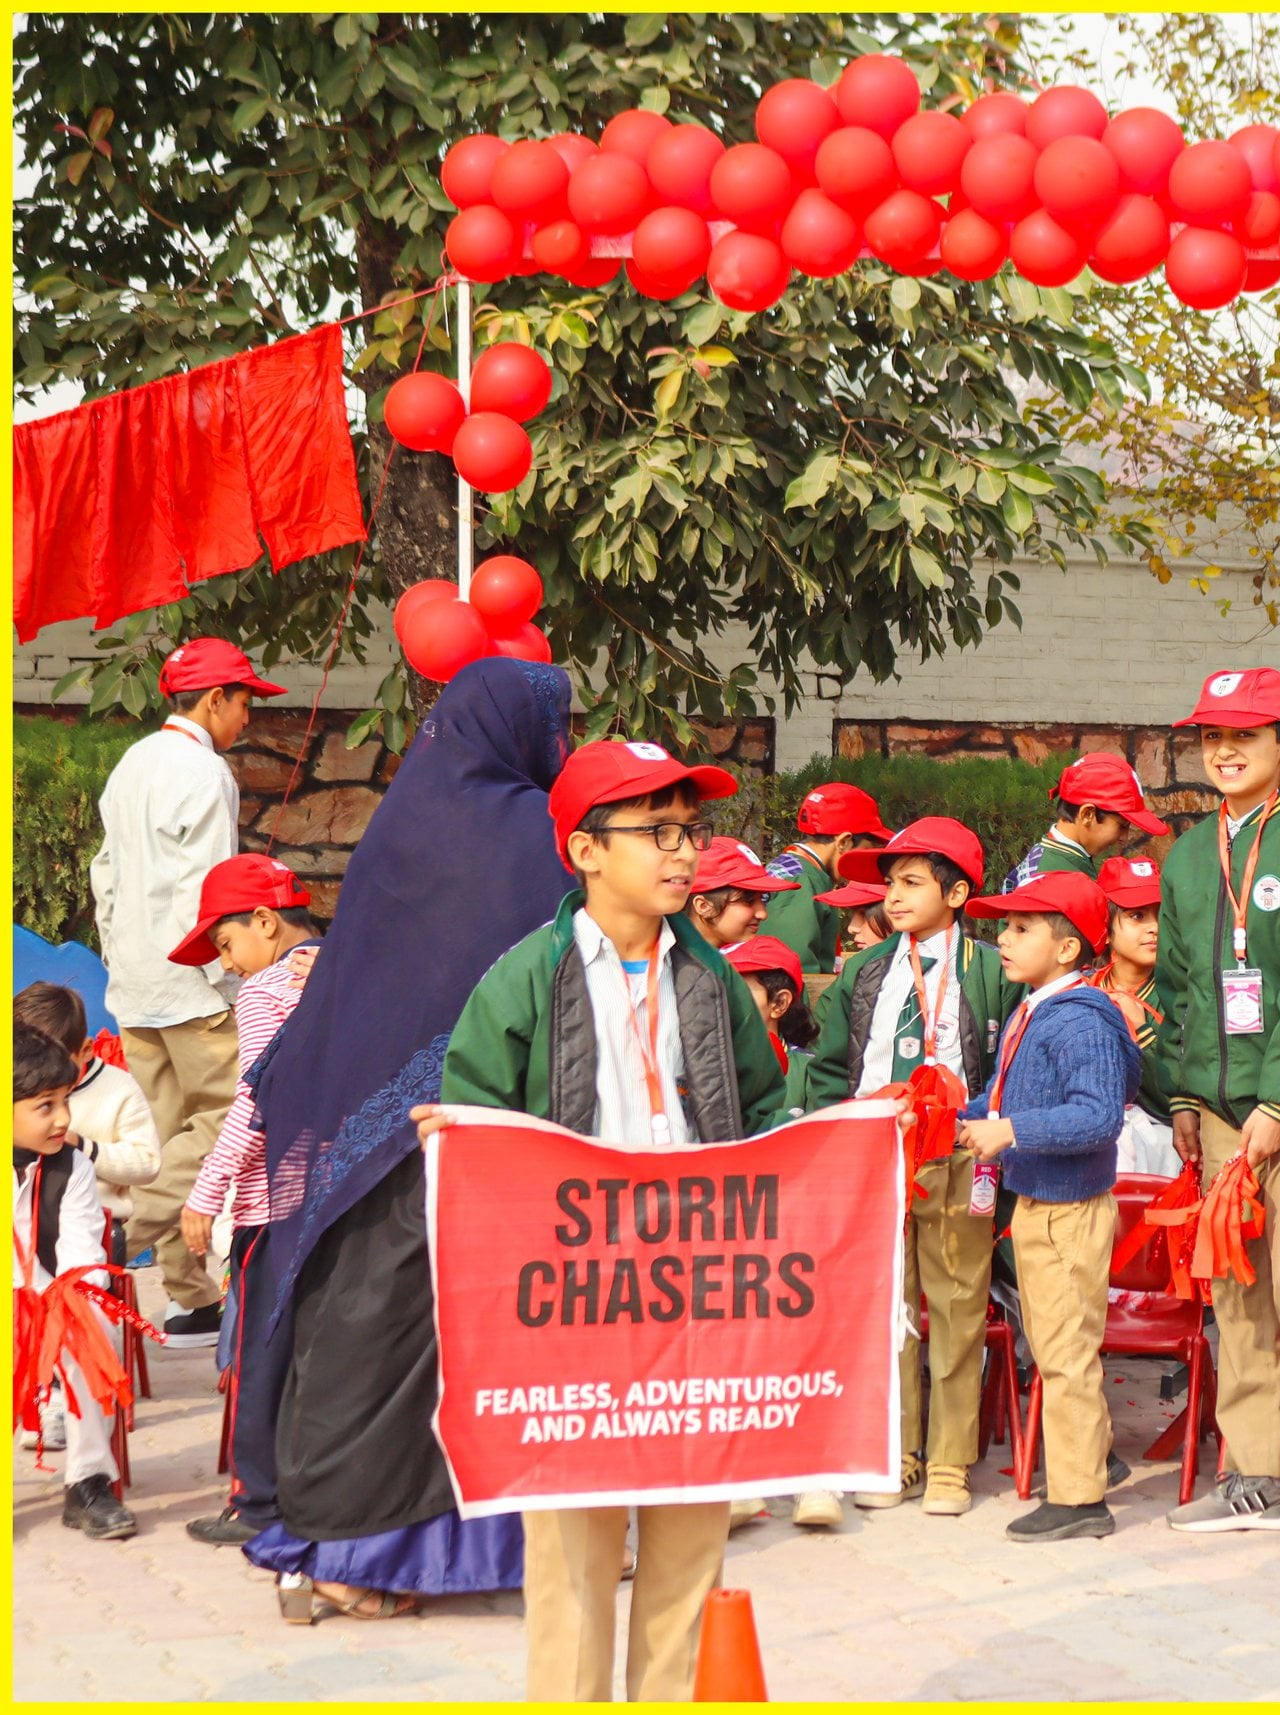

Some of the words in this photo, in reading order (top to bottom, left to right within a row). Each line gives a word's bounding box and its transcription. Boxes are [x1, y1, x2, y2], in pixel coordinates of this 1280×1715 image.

[555, 1174, 779, 1247] STORM
[516, 1252, 815, 1327] CHASERS
[475, 1382, 620, 1417] FEARLESS,
[624, 1370, 844, 1407] ADVENTUROUS,
[521, 1414, 587, 1444] AND
[591, 1407, 703, 1439] ALWAYS
[708, 1402, 801, 1434] READY
